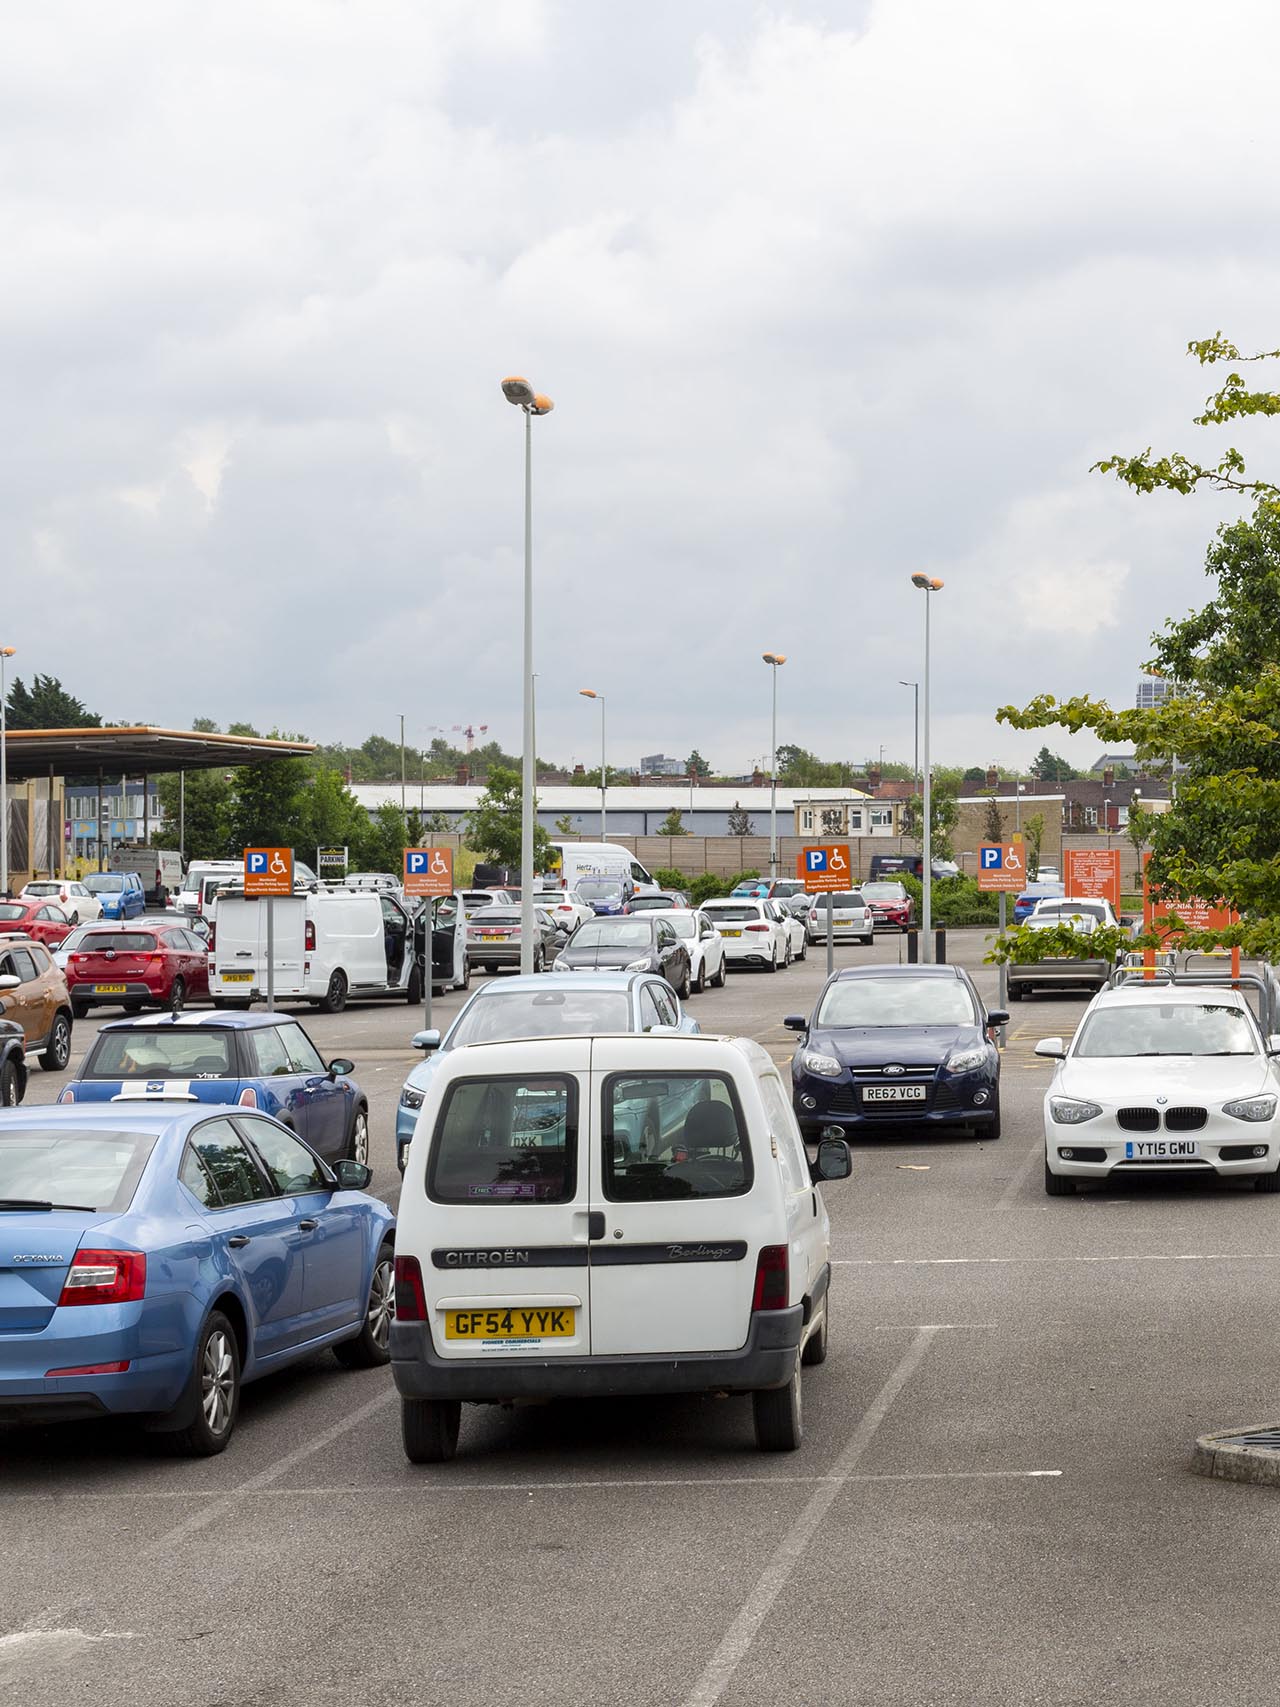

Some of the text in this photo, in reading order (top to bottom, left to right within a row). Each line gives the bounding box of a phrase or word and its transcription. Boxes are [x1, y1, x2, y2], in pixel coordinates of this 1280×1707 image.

[251, 854, 264, 872] P
[411, 854, 424, 872] P
[810, 851, 823, 869] P
[985, 850, 998, 867] P
[867, 1087, 921, 1100] RE62 VCG
[1137, 1142, 1166, 1155] YT15
[1169, 1142, 1195, 1154] GWU
[13, 1254, 64, 1262] OCTAVIA
[445, 1249, 529, 1265] CITROËN
[666, 1245, 732, 1259] Berlingo
[456, 1311, 565, 1334] GF54 YYK
